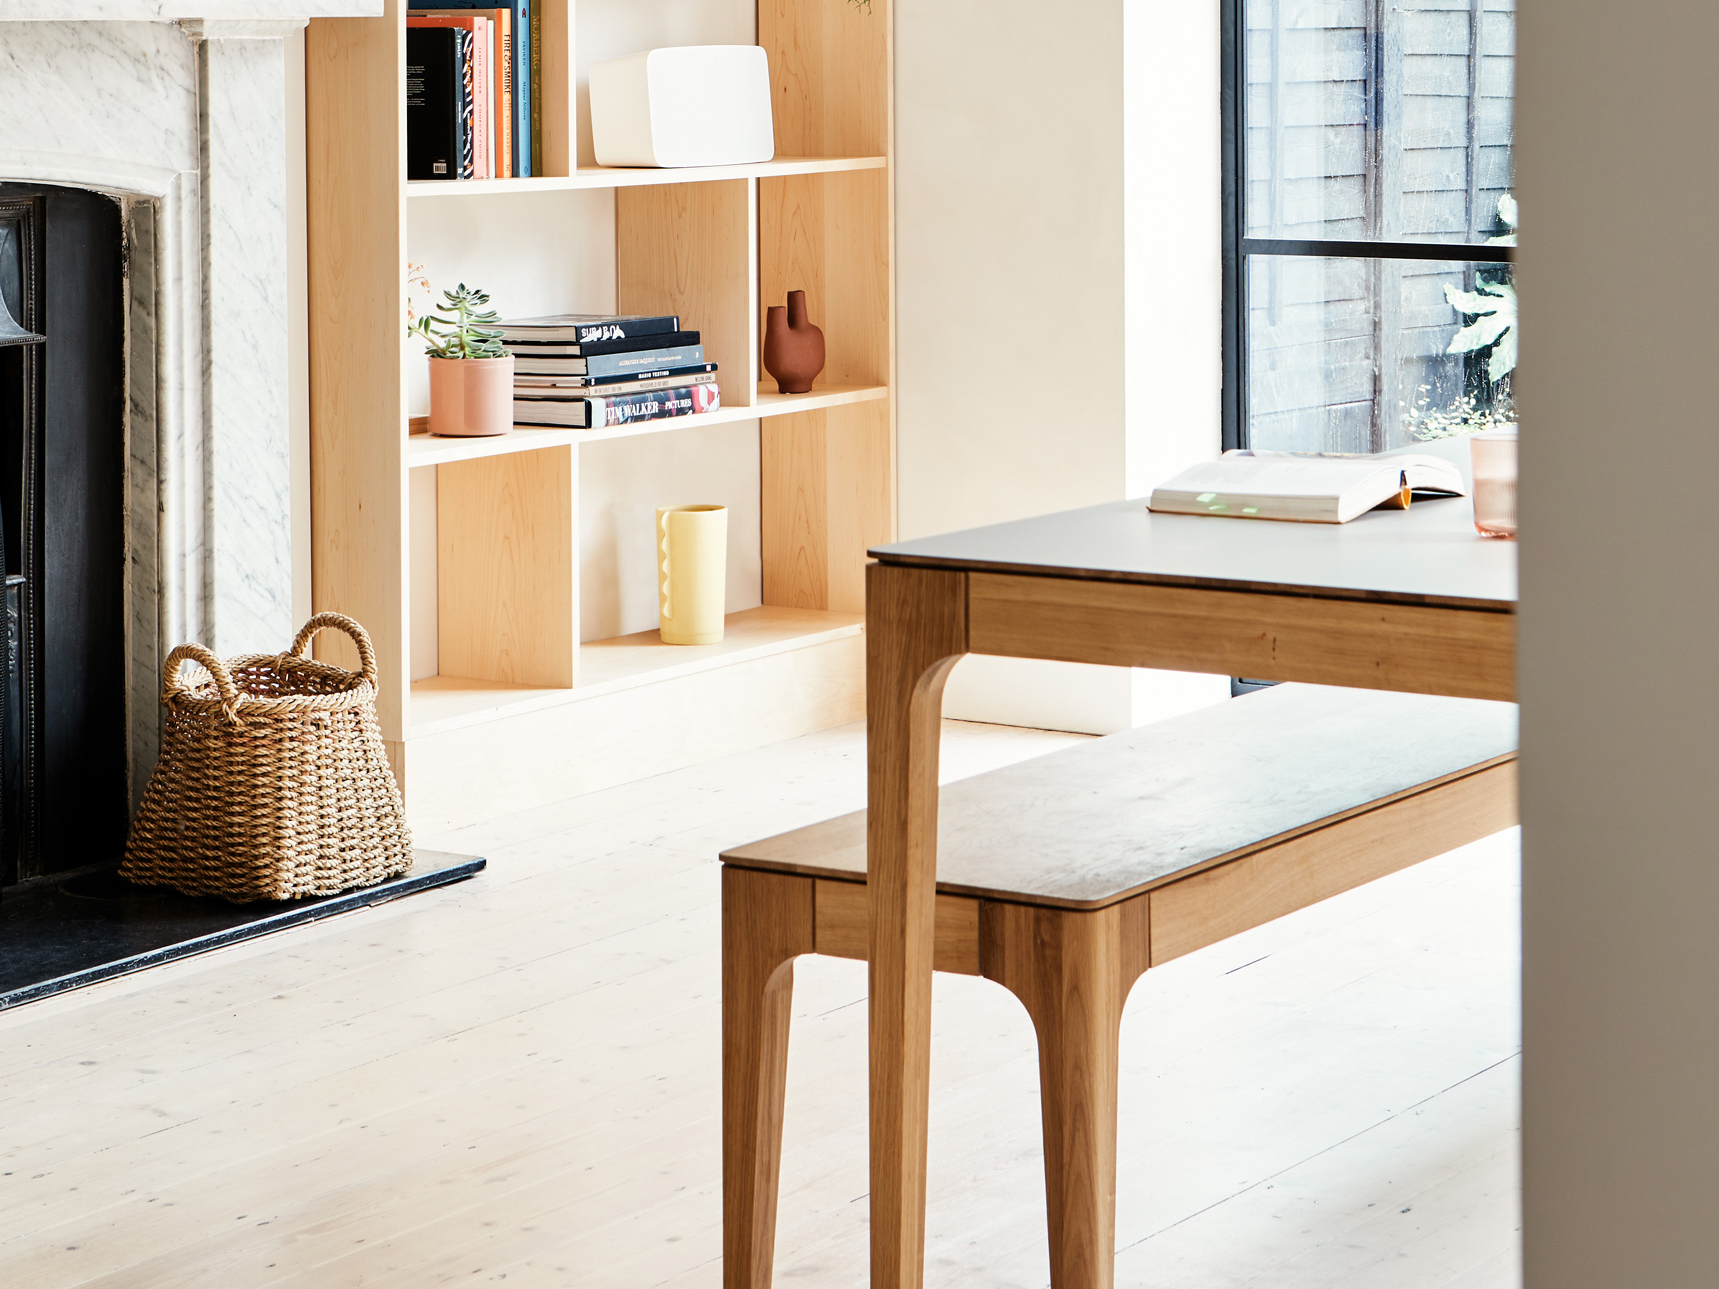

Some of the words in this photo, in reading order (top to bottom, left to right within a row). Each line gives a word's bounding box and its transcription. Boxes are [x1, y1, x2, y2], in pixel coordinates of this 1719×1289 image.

[503, 34, 511, 54] FIRE
[532, 15, 540, 70] MORBERG
[503, 65, 511, 95] SMOKE
[652, 370, 670, 378] TESTINO
[605, 405, 622, 420] TIM
[622, 401, 659, 416] WALKER
[665, 398, 692, 410] PICTURES
